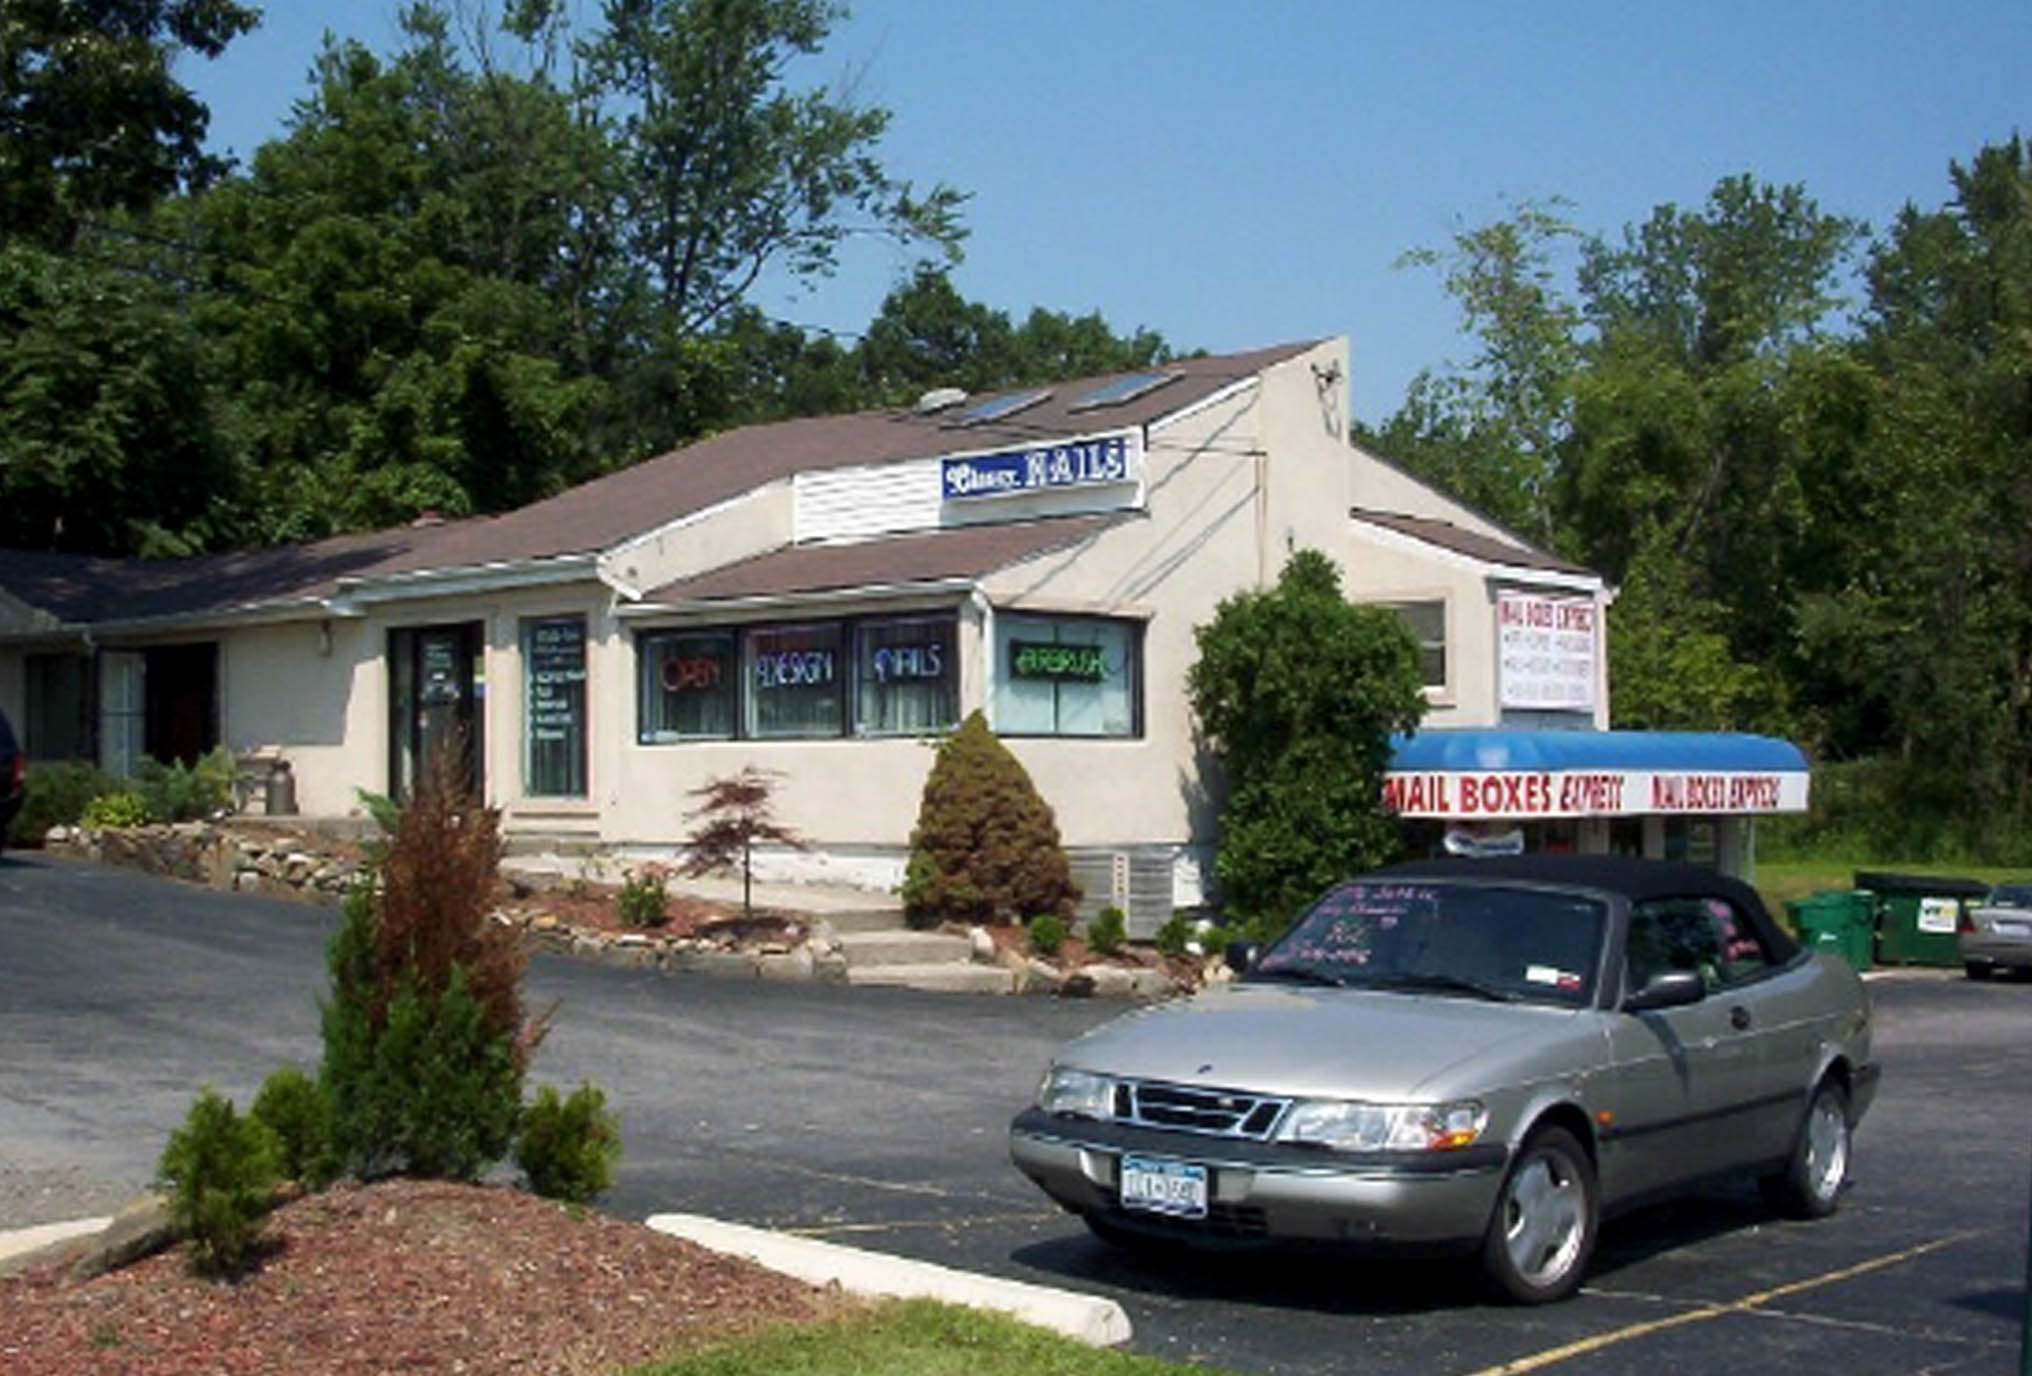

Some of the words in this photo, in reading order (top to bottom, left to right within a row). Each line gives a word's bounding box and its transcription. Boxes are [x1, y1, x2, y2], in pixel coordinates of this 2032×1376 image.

[1026, 440, 1122, 487] NAILS
[1385, 775, 1449, 812] MAIL
[1459, 775, 1551, 813] BOXES
